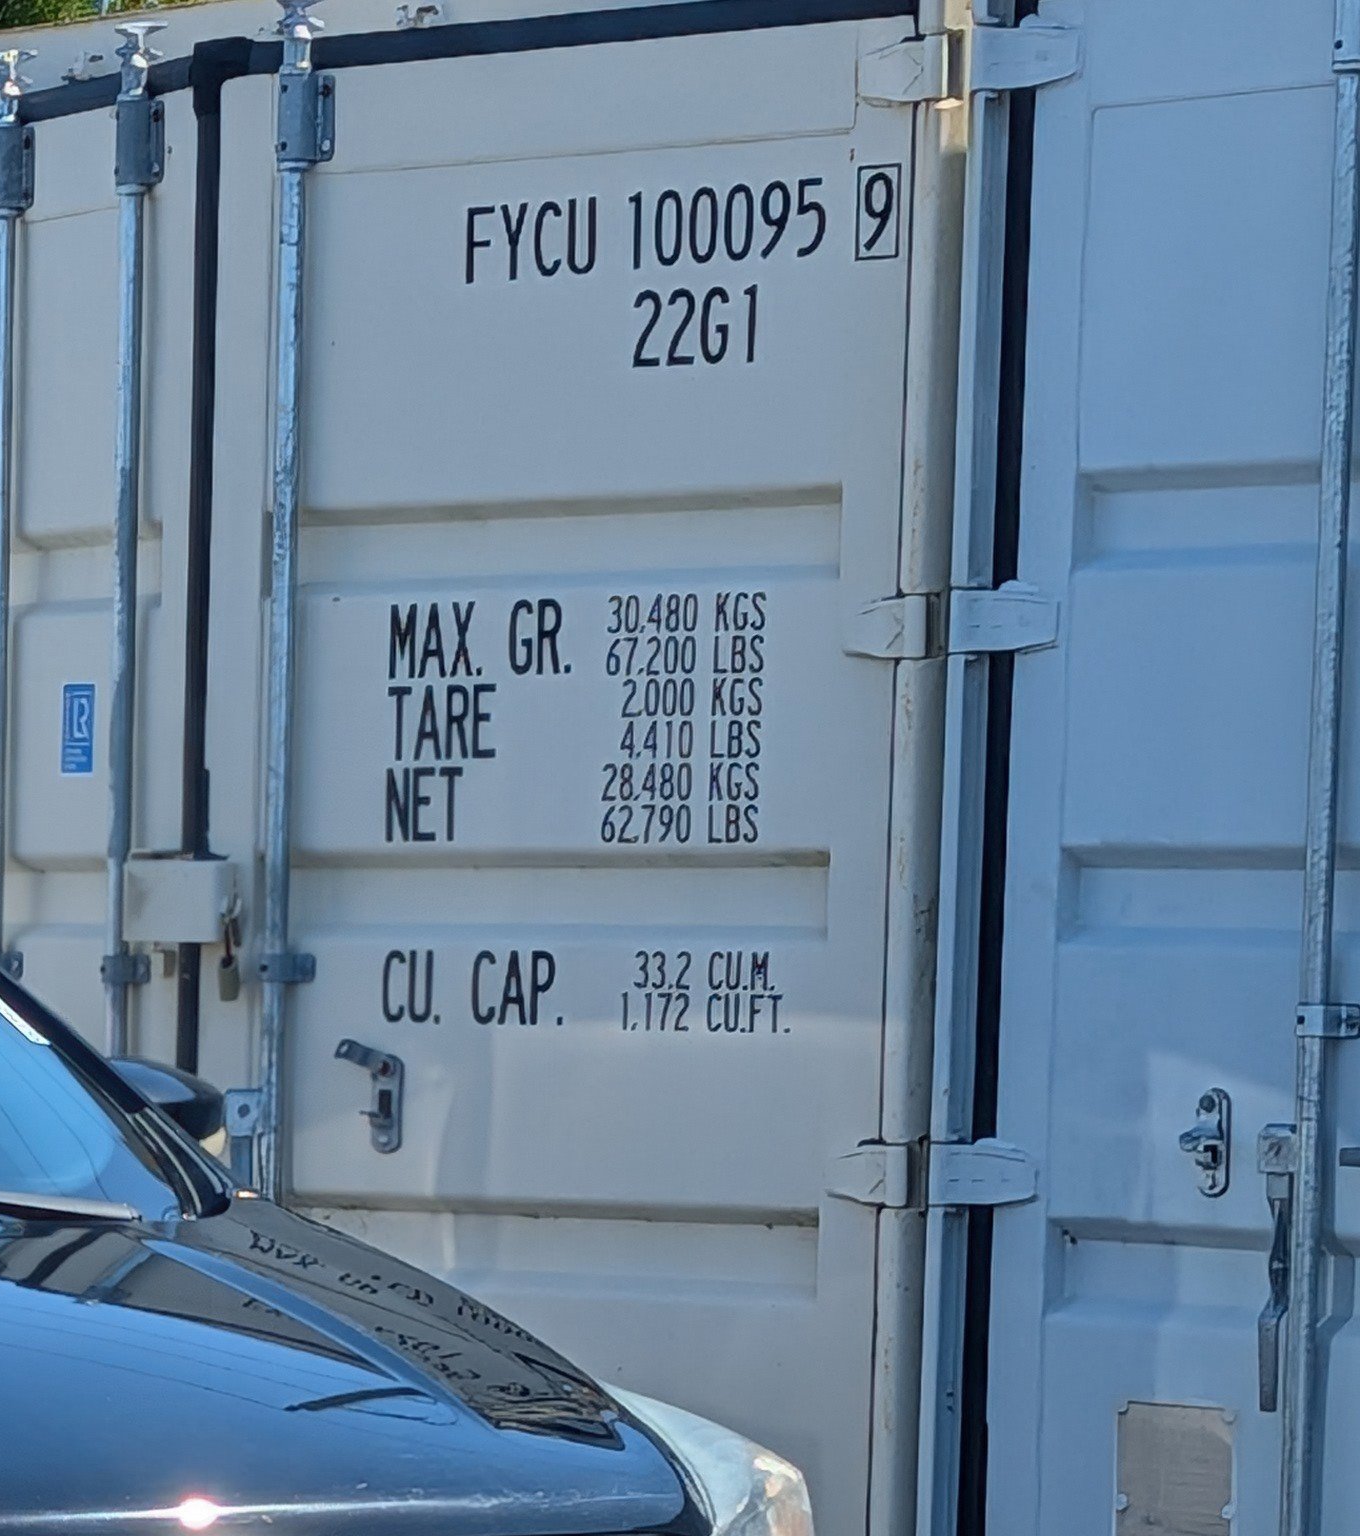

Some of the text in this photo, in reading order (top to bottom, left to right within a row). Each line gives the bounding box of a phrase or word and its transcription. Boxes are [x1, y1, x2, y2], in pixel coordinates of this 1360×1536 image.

[465, 172, 894, 284] FYCU 100095 9
[632, 284, 758, 368] 22G1
[715, 592, 766, 632] KGS
[389, 598, 572, 679] MAX. GR.
[713, 635, 765, 674] LBS
[710, 678, 763, 716] KGS
[388, 683, 497, 761] TARE
[709, 720, 761, 758] LBS
[708, 763, 760, 801] KGS
[384, 766, 463, 842] NET
[707, 804, 759, 843] LBS
[382, 949, 564, 1025] CU. CAP.
[708, 951, 776, 991] CU.M.
[706, 992, 791, 1033] CU.FT.
